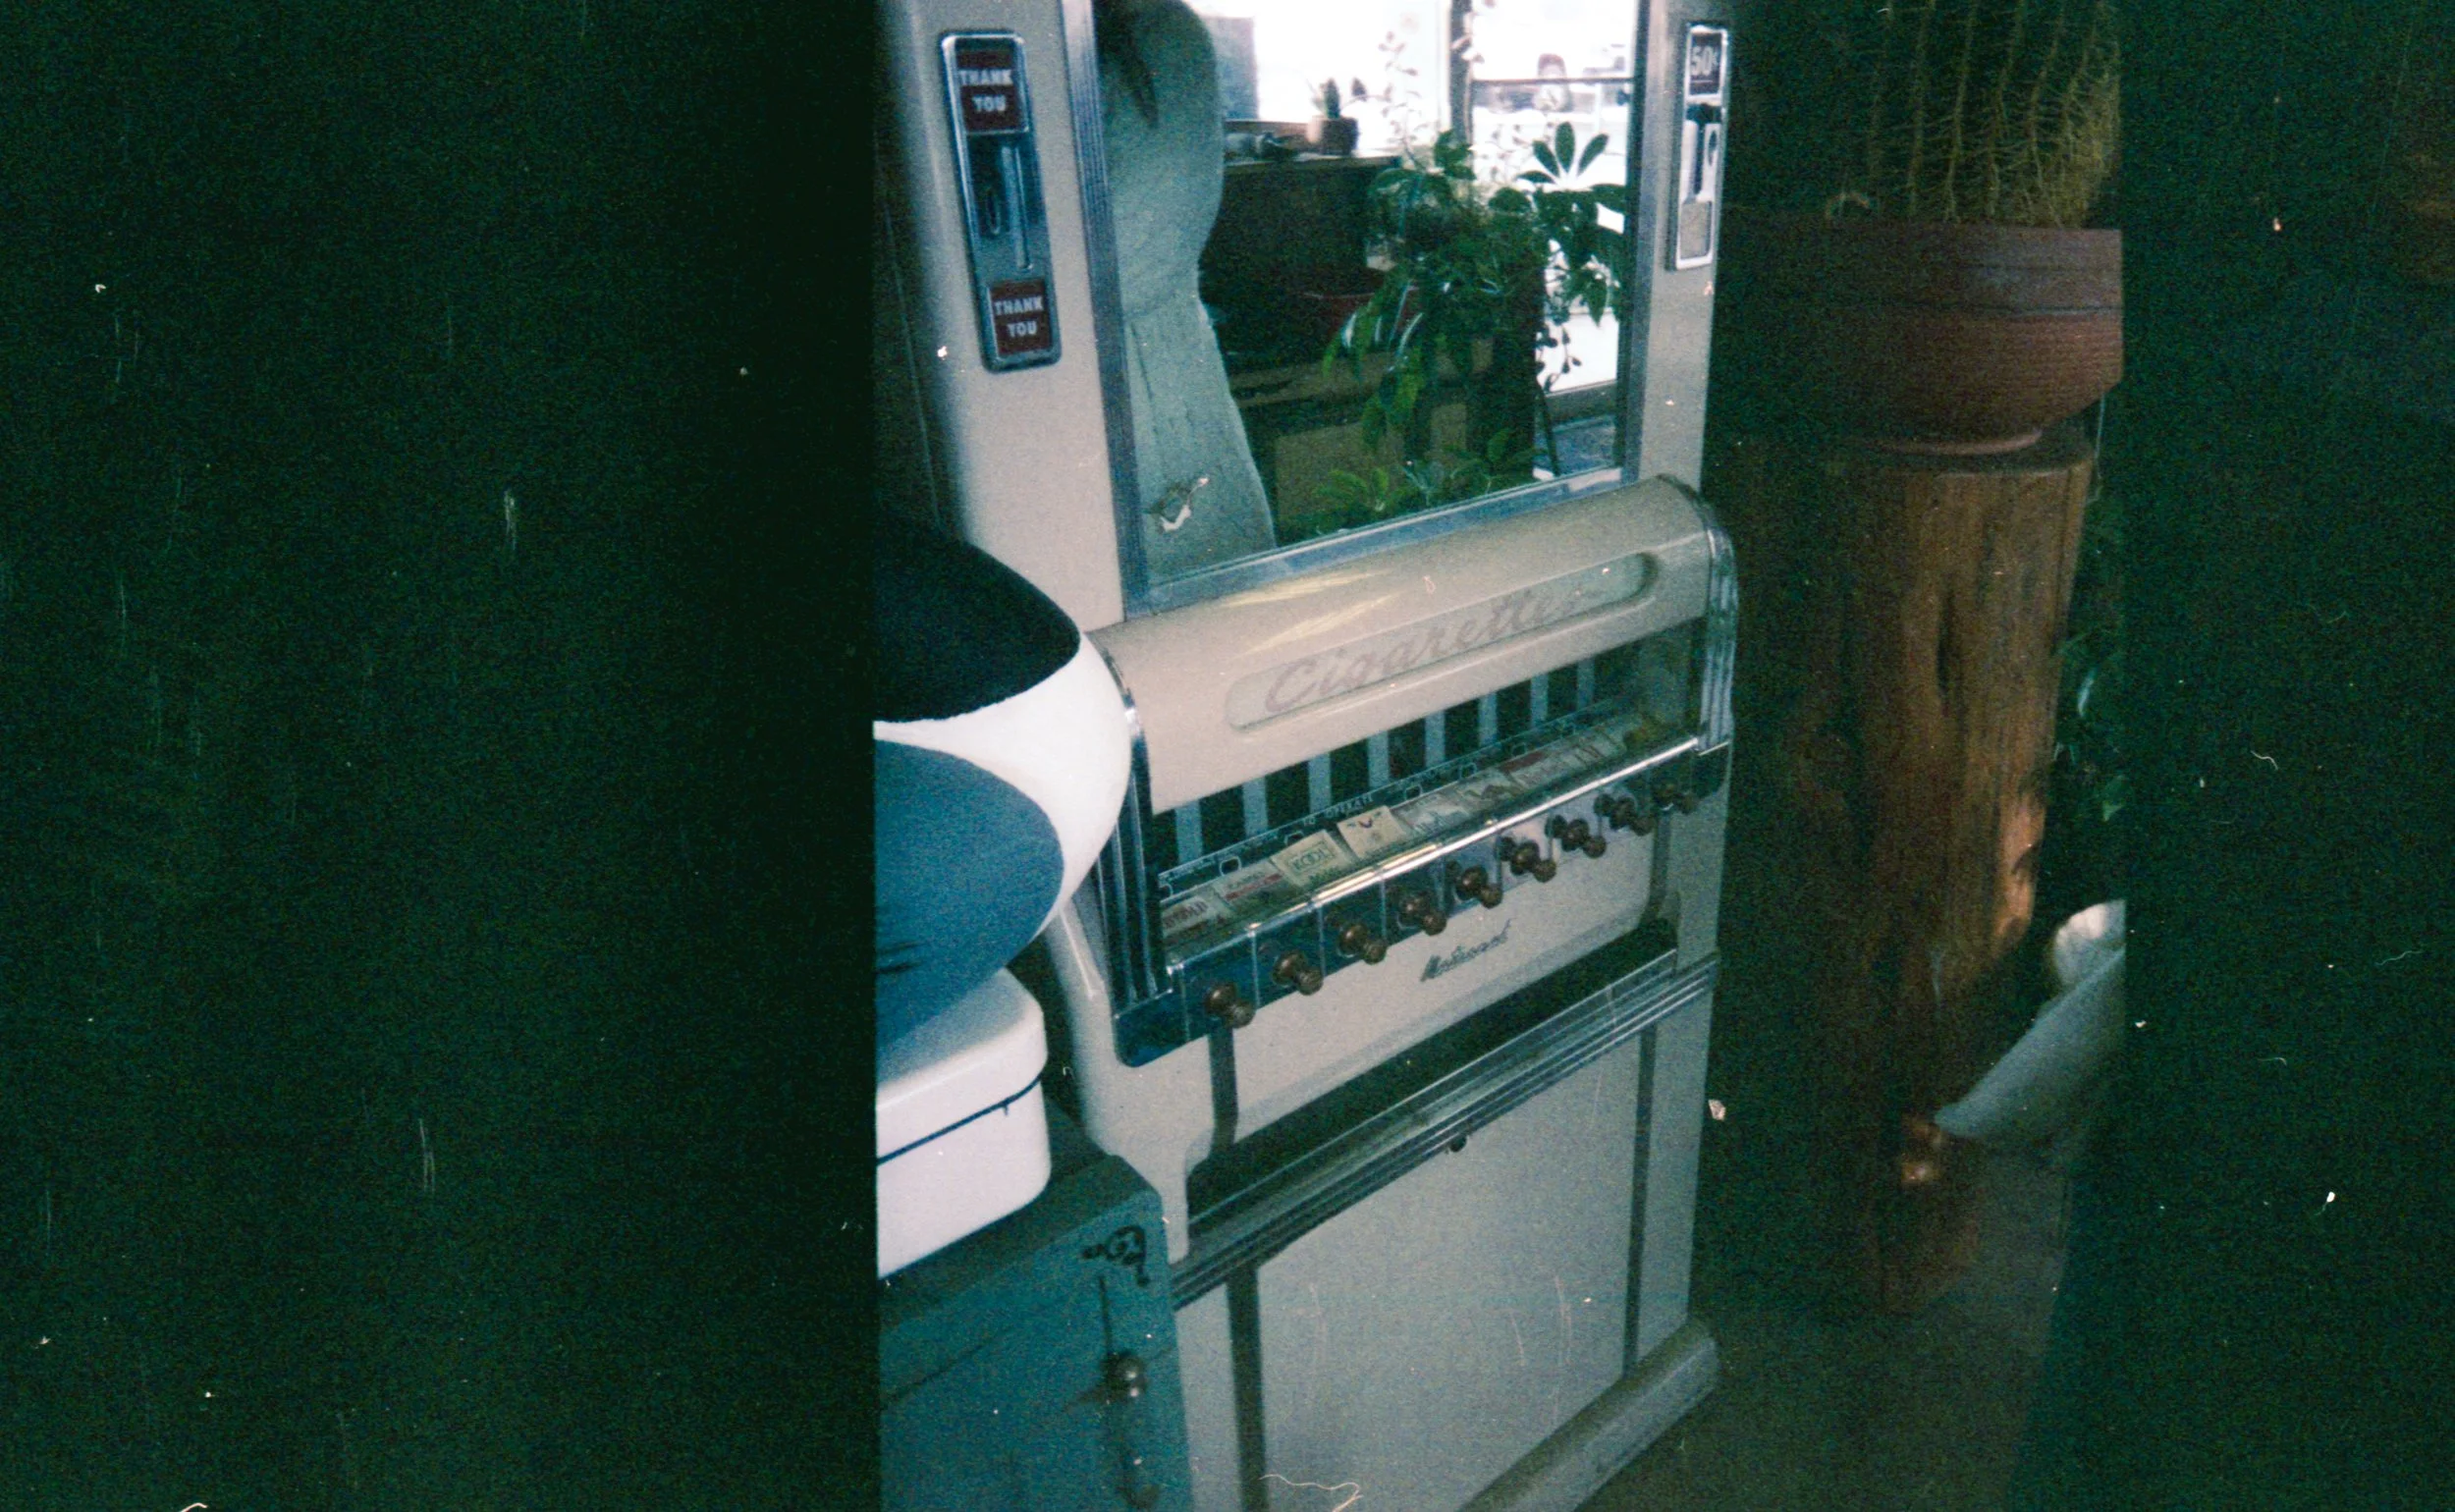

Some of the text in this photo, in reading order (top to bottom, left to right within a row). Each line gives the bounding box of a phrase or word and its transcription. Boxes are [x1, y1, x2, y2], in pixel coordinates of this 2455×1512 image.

[958, 69, 1013, 86] THANK
[971, 94, 1007, 112] YOU
[993, 297, 1043, 315] THANK
[1007, 320, 1037, 337] YOU
[1290, 845, 1332, 870] KOOL
